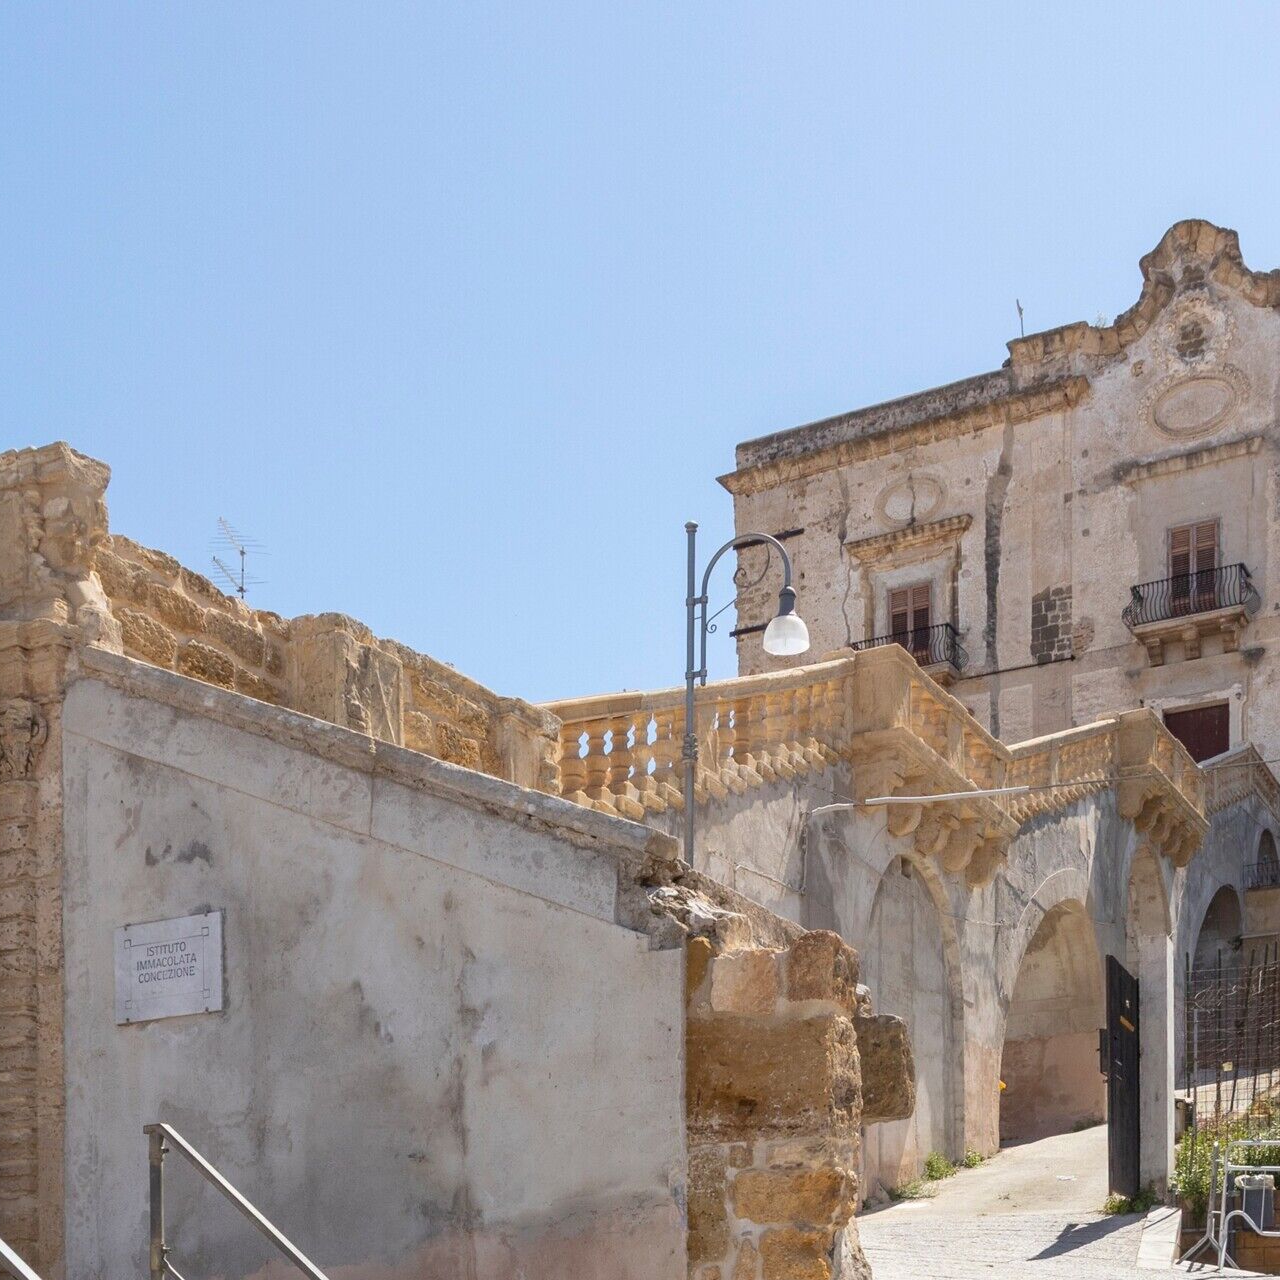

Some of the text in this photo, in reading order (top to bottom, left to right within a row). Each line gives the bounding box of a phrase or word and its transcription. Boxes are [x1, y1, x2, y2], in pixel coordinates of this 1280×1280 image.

[146, 941, 187, 957] ISTITUTO
[136, 952, 197, 972] IMMACOLATA
[138, 965, 196, 984] CONCEZIONE
